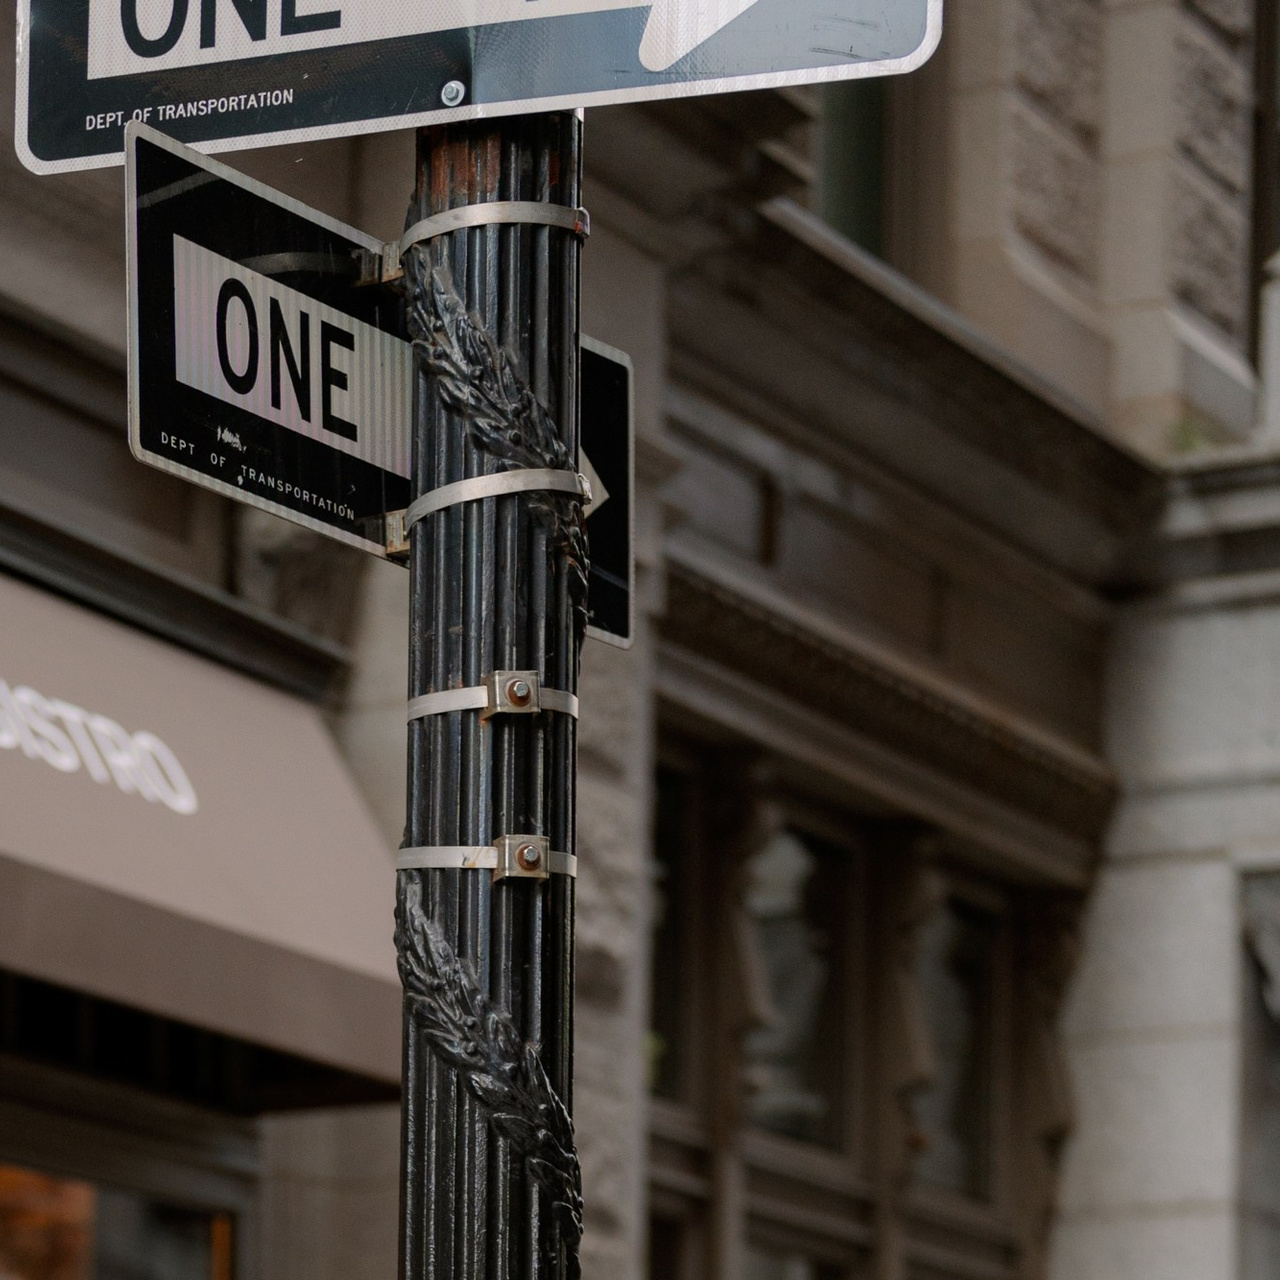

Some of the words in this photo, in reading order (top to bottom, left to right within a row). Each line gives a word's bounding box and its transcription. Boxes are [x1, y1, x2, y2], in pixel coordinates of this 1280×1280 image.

[85, 112, 127, 130] DEPT.
[131, 107, 153, 123] OF
[157, 89, 294, 121] TRANSPORTATION
[216, 278, 358, 443] ONE
[161, 431, 195, 455] DEPT
[210, 453, 227, 468] OF
[241, 465, 355, 522] TRANSPORTATION
